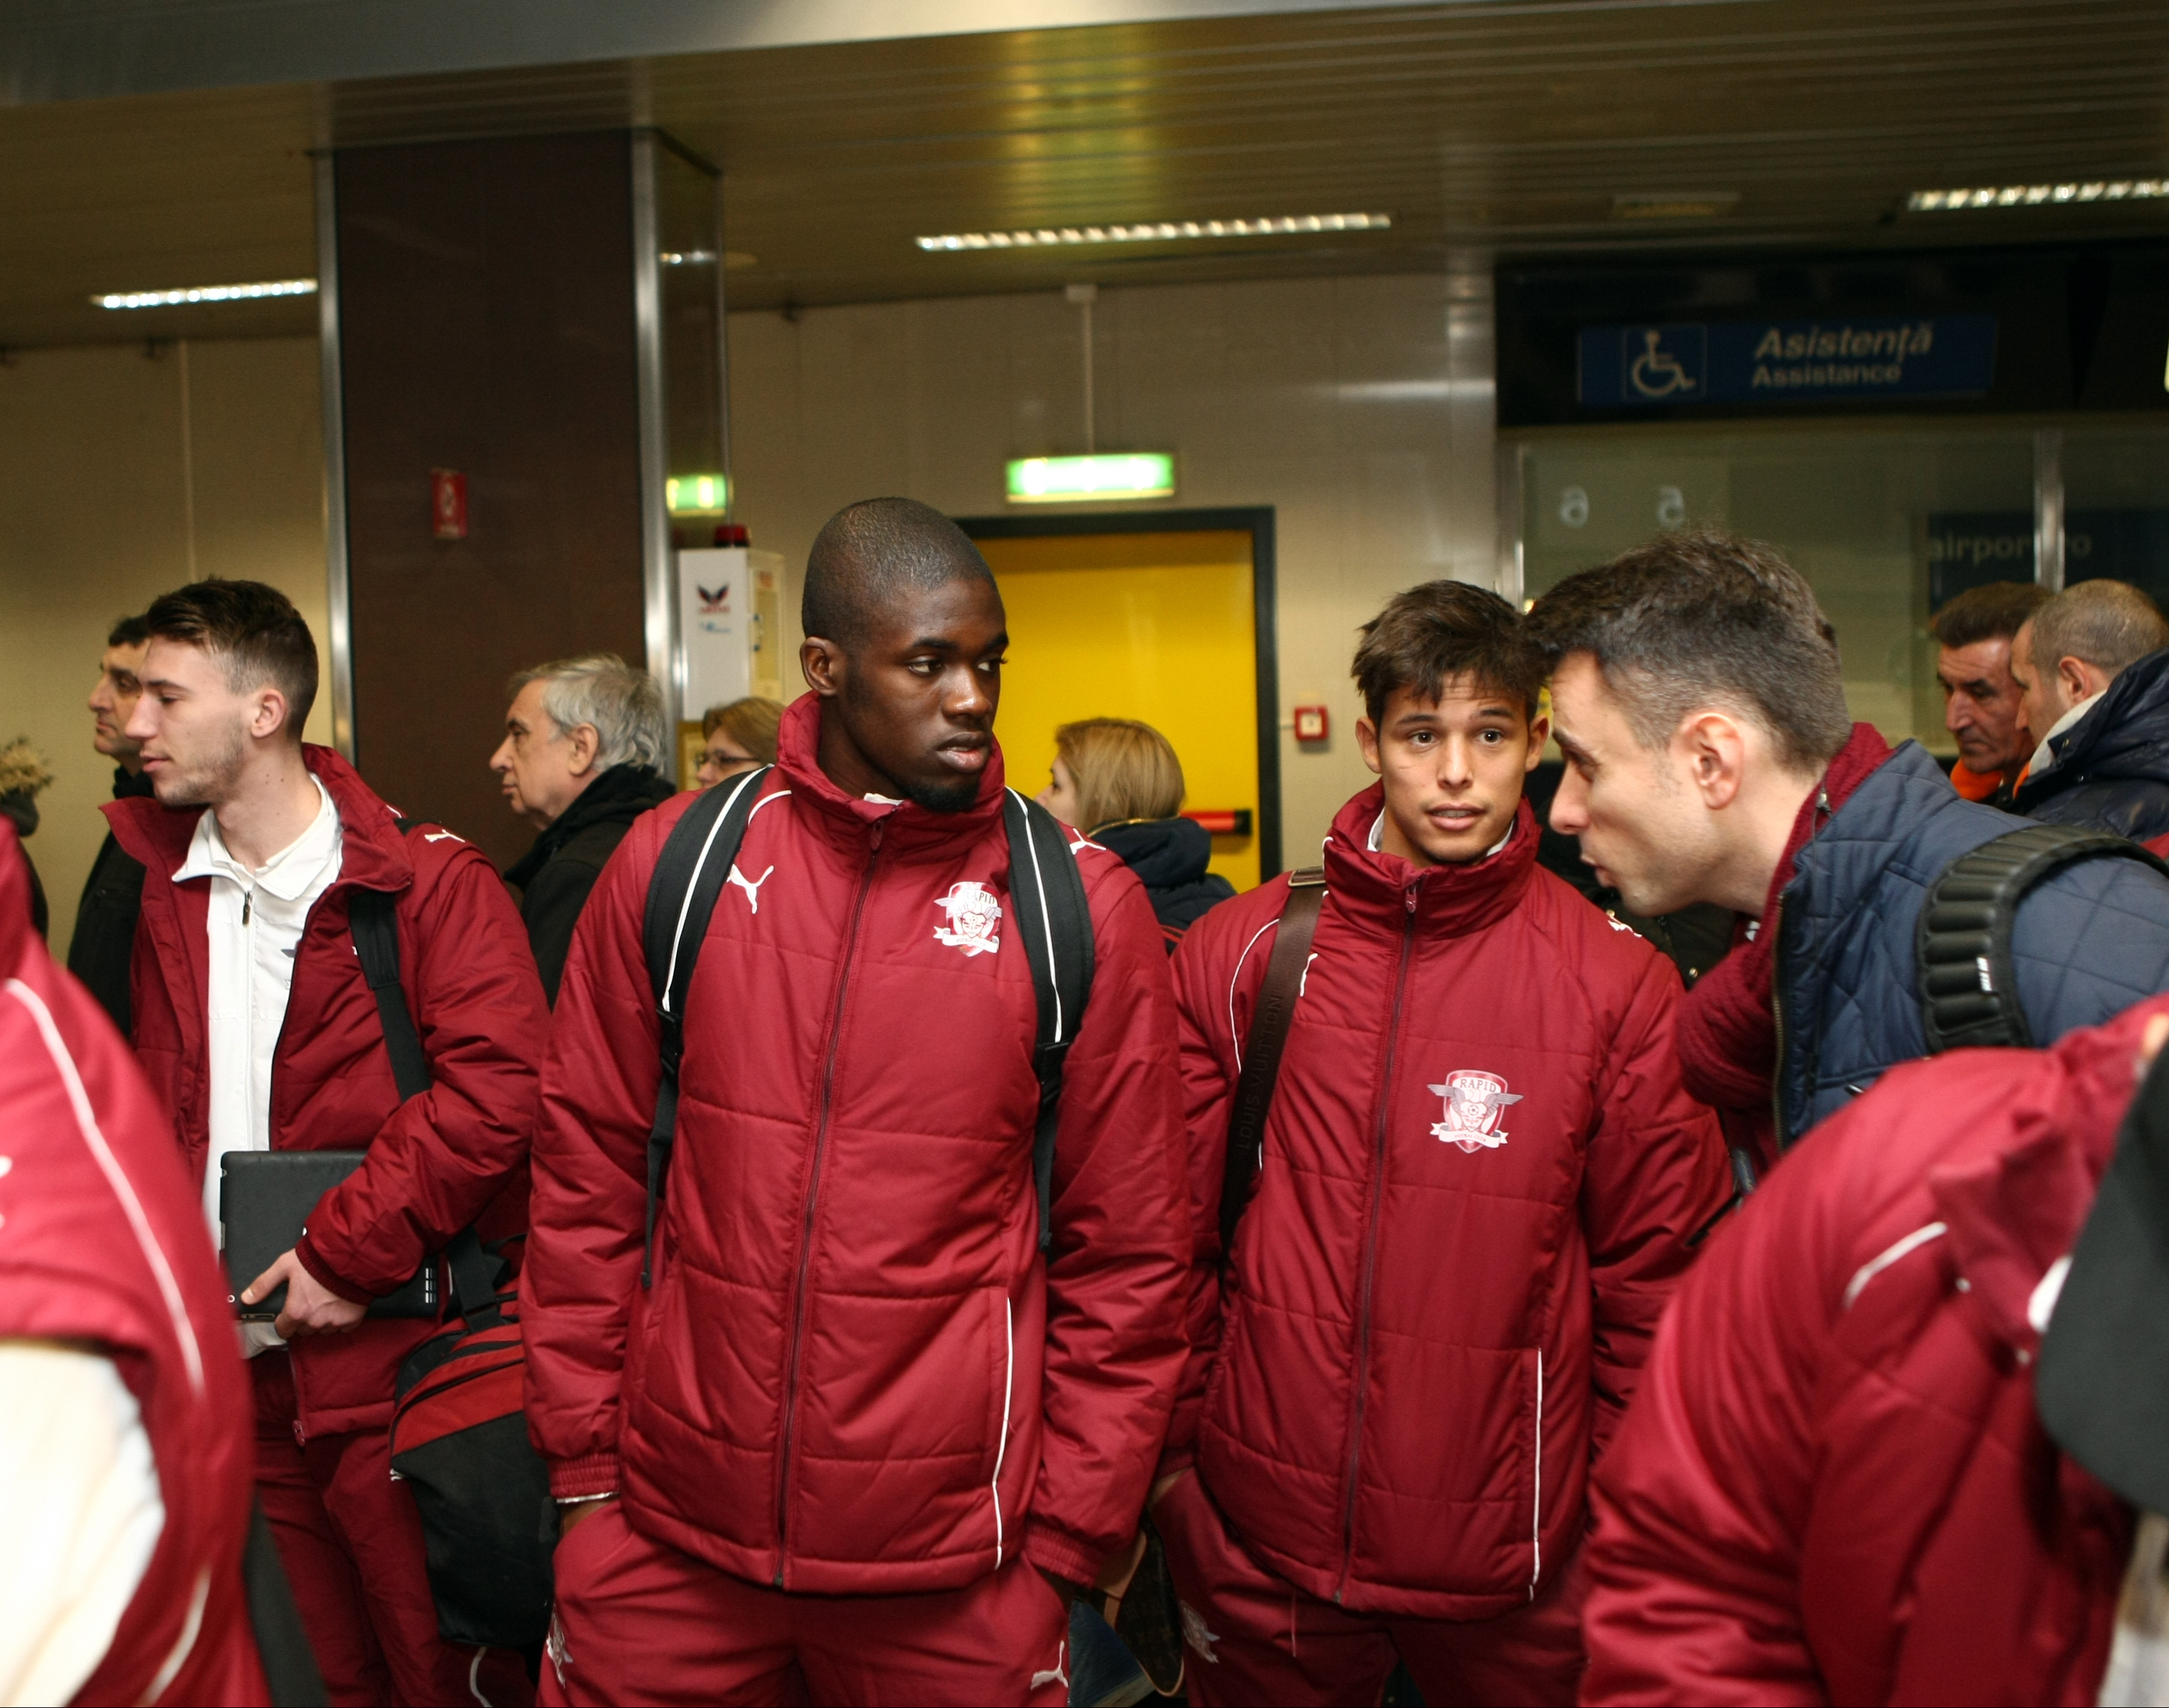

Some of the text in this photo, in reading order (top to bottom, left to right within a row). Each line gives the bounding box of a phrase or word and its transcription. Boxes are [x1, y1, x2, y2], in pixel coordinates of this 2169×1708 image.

[1751, 362, 1902, 389] Assistance
[1238, 995, 1282, 1149] LOUIS VUITTON
[1460, 1079, 1497, 1093] RAPID
